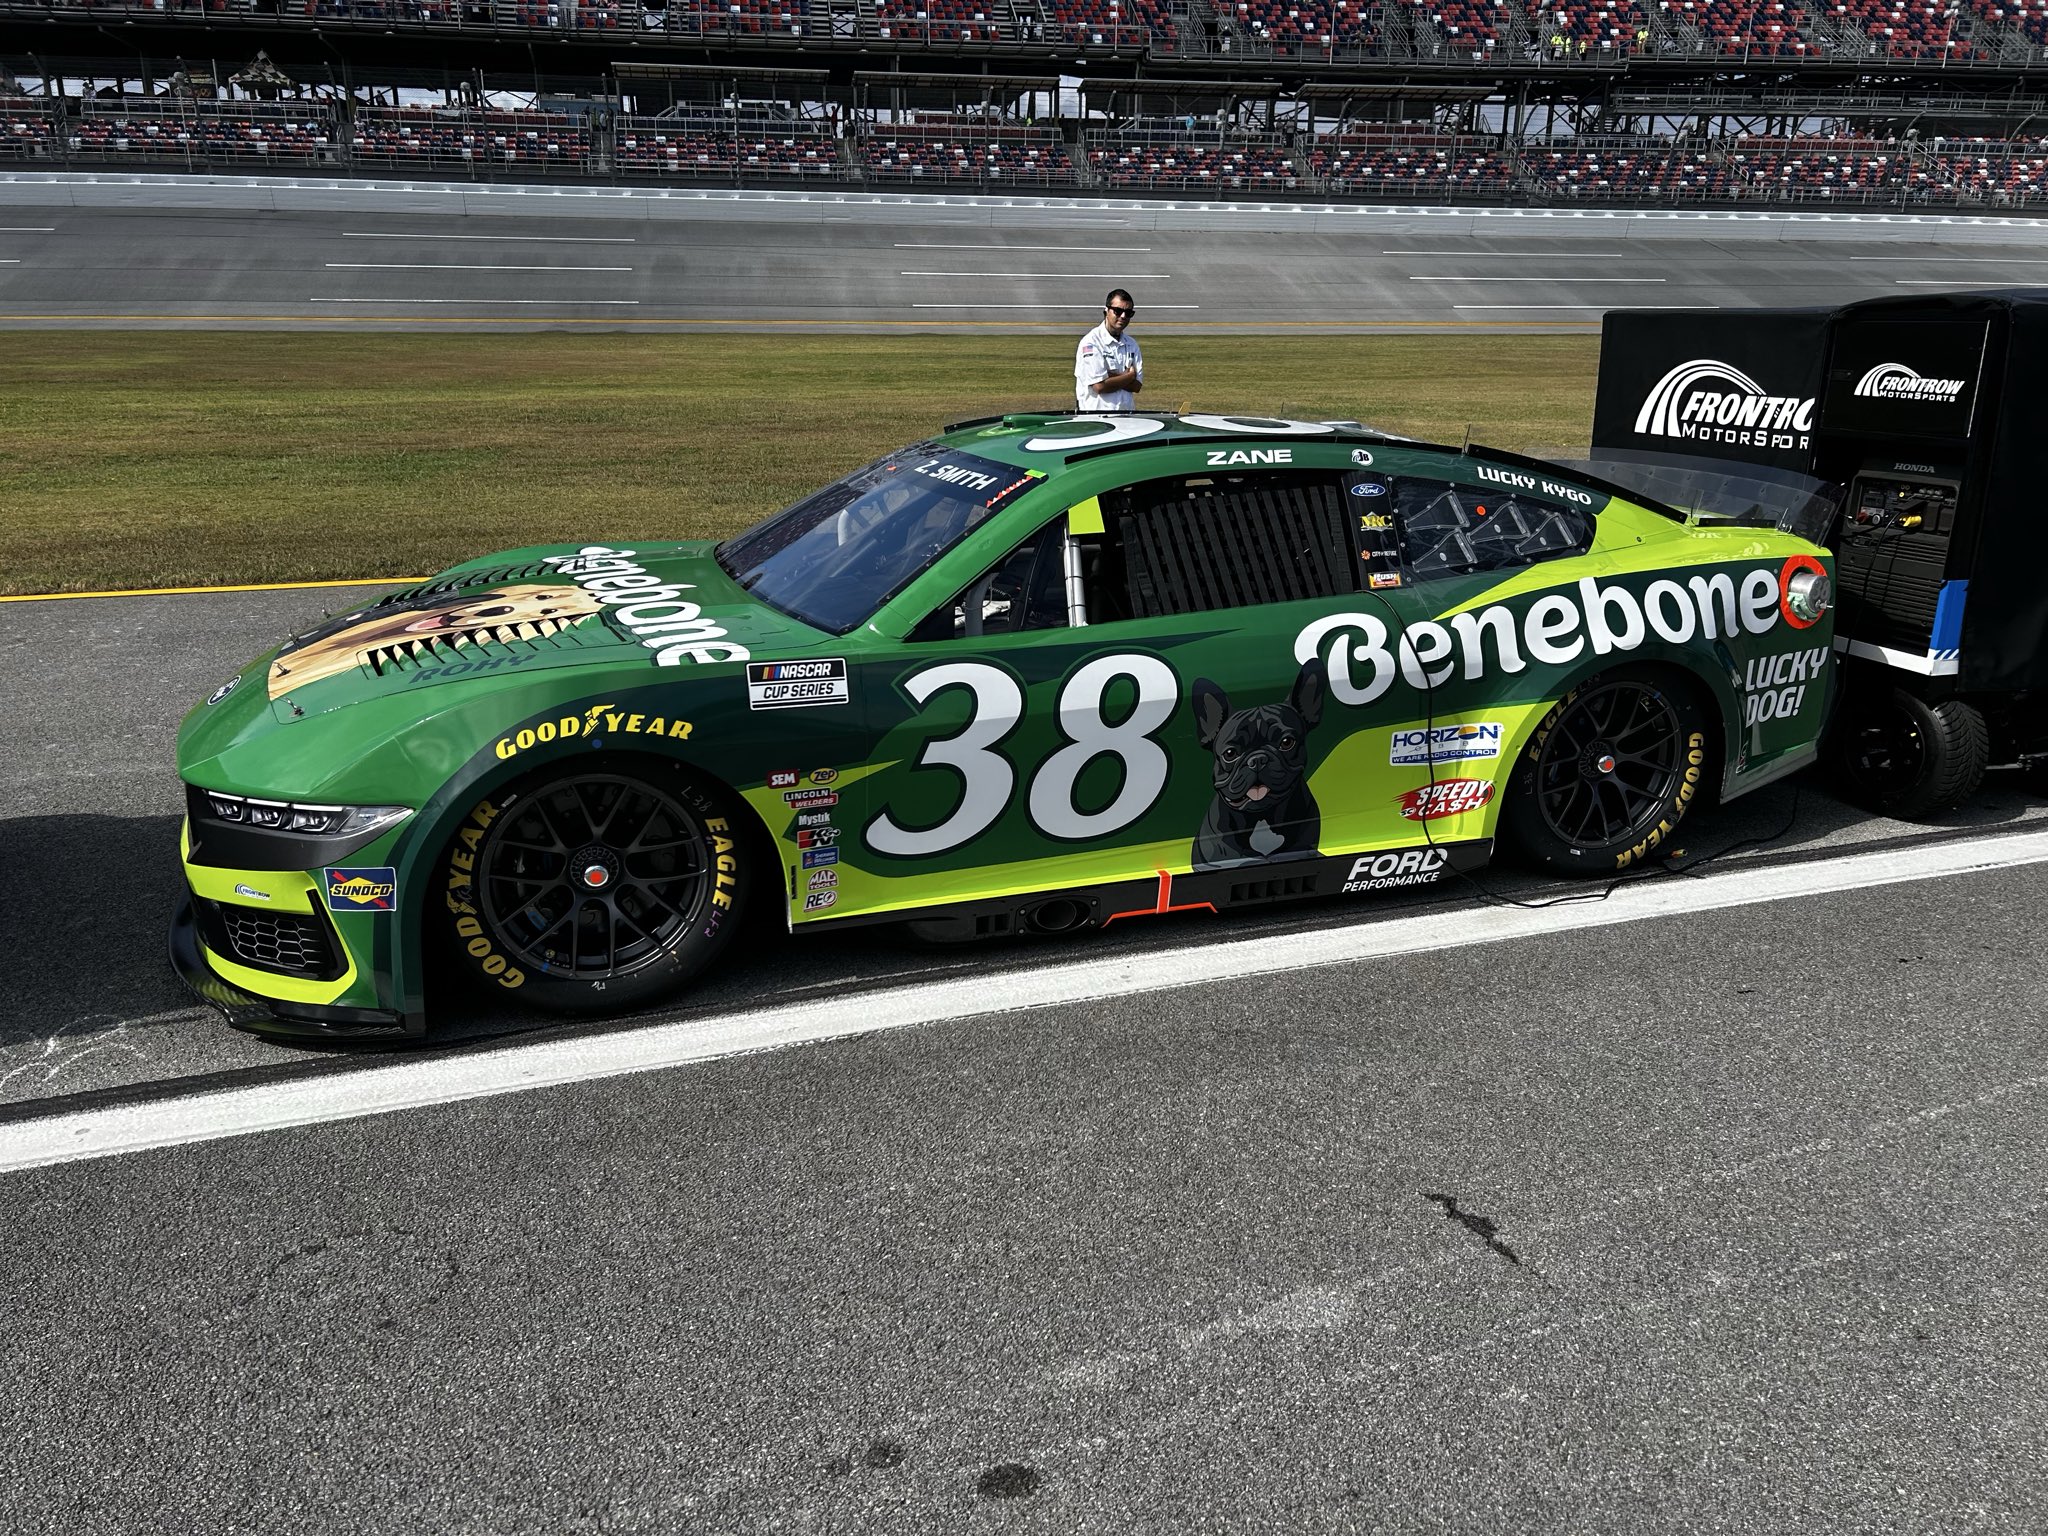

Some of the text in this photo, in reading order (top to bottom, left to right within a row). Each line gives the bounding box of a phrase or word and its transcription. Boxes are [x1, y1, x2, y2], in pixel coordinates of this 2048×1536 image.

[1879, 376, 1965, 395] FRONTROW
[1682, 423, 1810, 450] MOTORSPOR
[1206, 449, 1293, 466] ZANE
[1893, 463, 1935, 474] HONDA
[929, 464, 998, 491] SMITH
[1477, 466, 1592, 506] LUCKY KYGO
[542, 546, 751, 667] Benebone
[1294, 568, 1780, 706] Benebone
[780, 662, 832, 679] NASCAR
[1745, 646, 1829, 692] LUCKY
[763, 682, 835, 699] CUP SERIES
[1745, 685, 1806, 729] DOG!
[1528, 687, 1578, 762] EAGLE
[1393, 725, 1498, 748] HORIZON
[866, 653, 1178, 855] 38
[1406, 754, 1422, 762] ARE
[1450, 748, 1496, 756] CONTROL
[771, 773, 796, 786] SEM
[785, 790, 829, 801] LINCOLN
[795, 798, 834, 807] WELDERS
[1416, 780, 1492, 805] SPEEDY
[798, 812, 831, 826] Mystik
[704, 816, 737, 911] EAGLE
[1347, 848, 1448, 880] FORD
[809, 870, 837, 885] MAC
[810, 881, 837, 890] TOOLS
[1341, 871, 1440, 893] PERFORMANCE
[333, 885, 393, 897] SUNOCO
